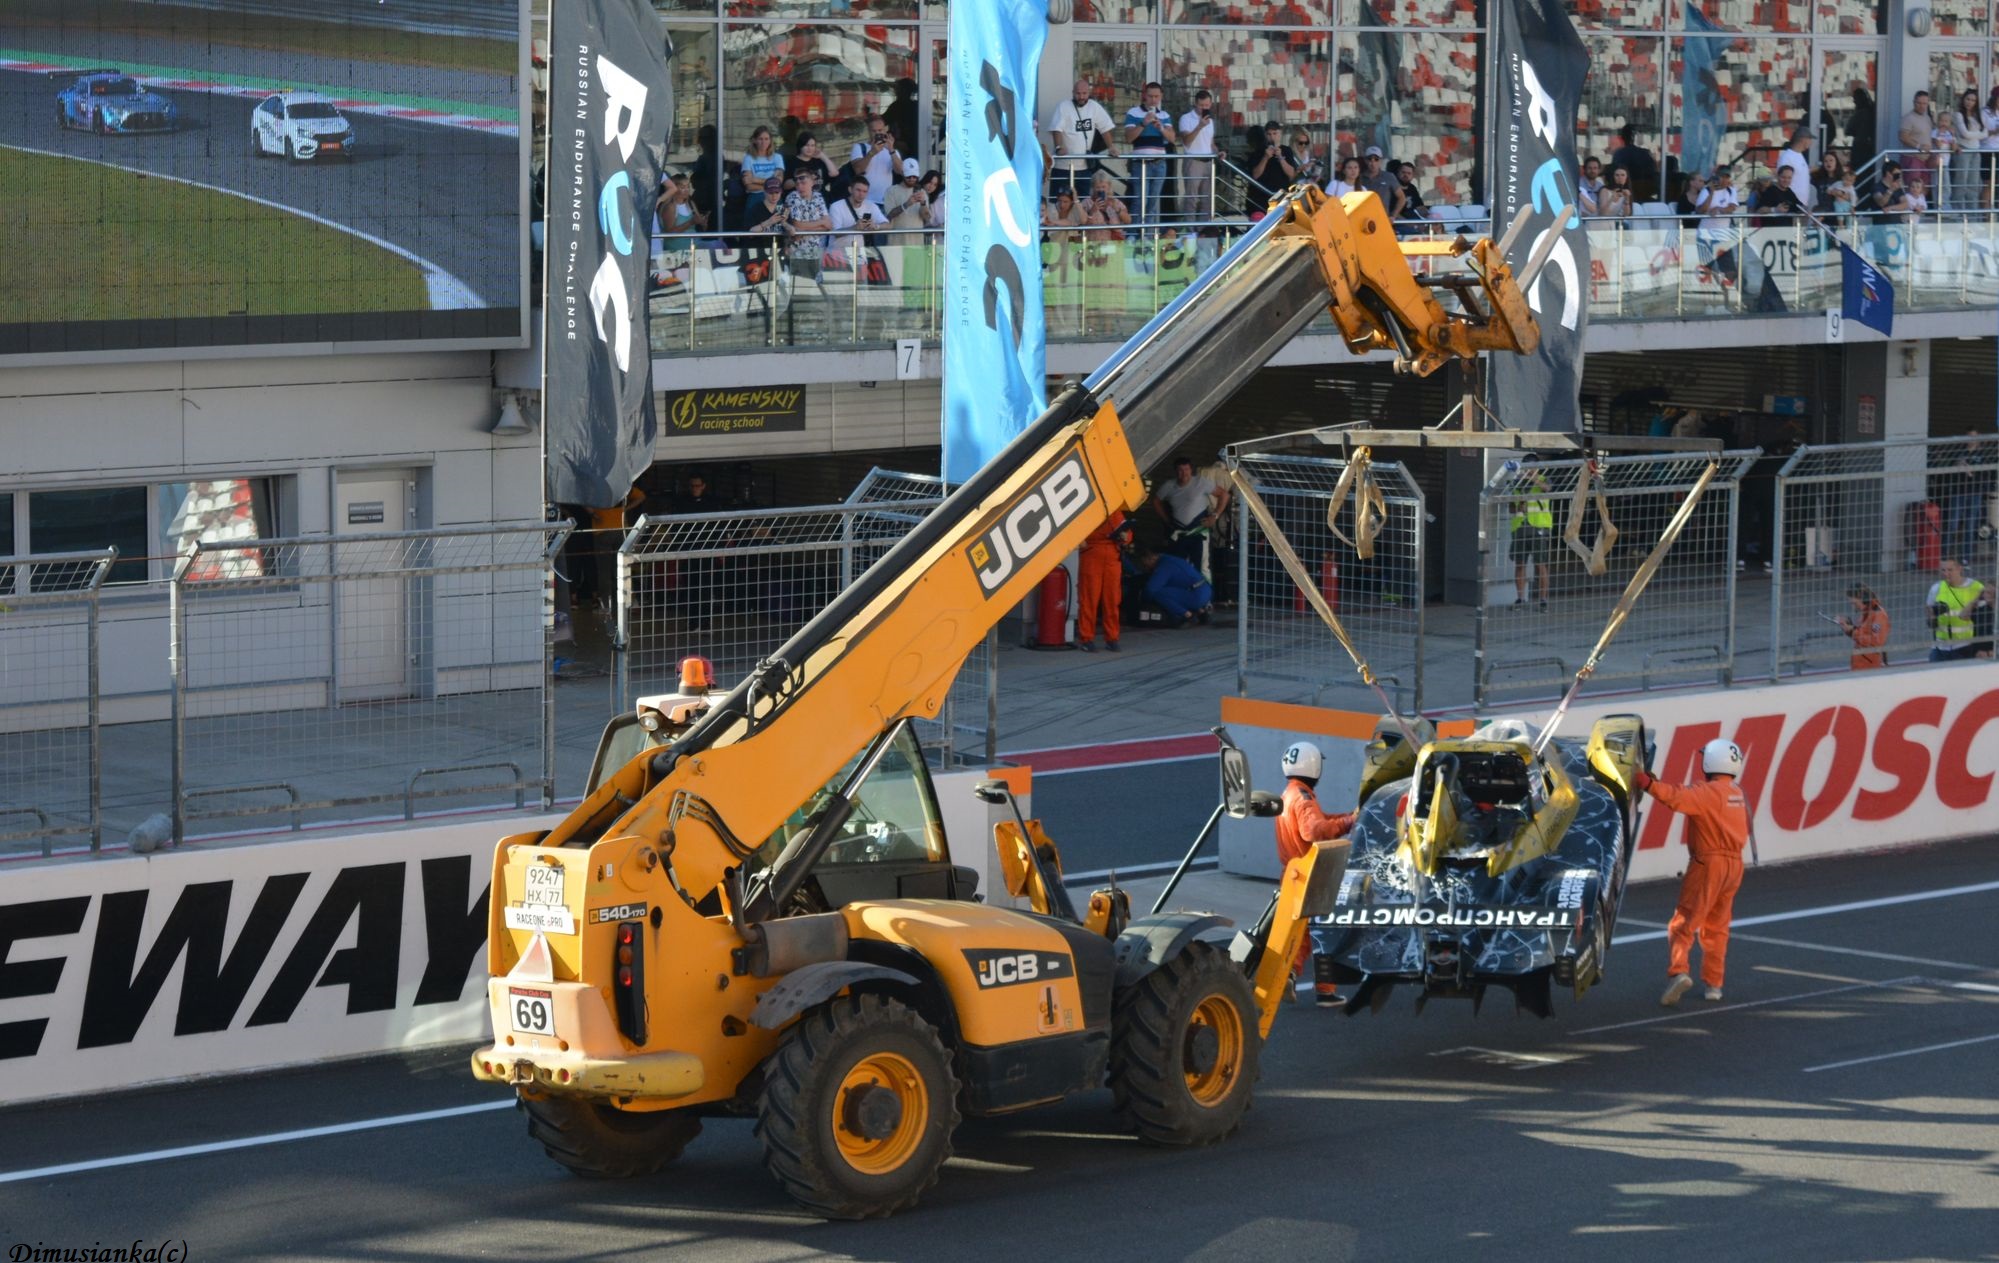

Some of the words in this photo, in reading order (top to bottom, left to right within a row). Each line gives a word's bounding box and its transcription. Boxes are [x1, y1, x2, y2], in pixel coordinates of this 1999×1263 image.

[576, 44, 589, 119] RUSSIAN
[572, 129, 586, 232] ENDURANCE
[961, 128, 972, 225] ENDURANCE
[1507, 124, 1520, 213] ENDURANCE
[566, 241, 578, 340] CHALLENGE
[959, 234, 971, 327] CHALLENGE
[1831, 314, 1840, 338] 9
[903, 346, 914, 373] 7
[702, 389, 800, 409] KAMENSKIY
[700, 418, 730, 431] racing
[732, 416, 764, 429] school
[979, 460, 1090, 590] JCB
[530, 868, 559, 886] 9247
[548, 891, 560, 904] 77
[1315, 908, 1571, 926] ТРАНСПРОМСТРО
[980, 953, 1038, 986] JCB
[516, 999, 547, 1030] 69
